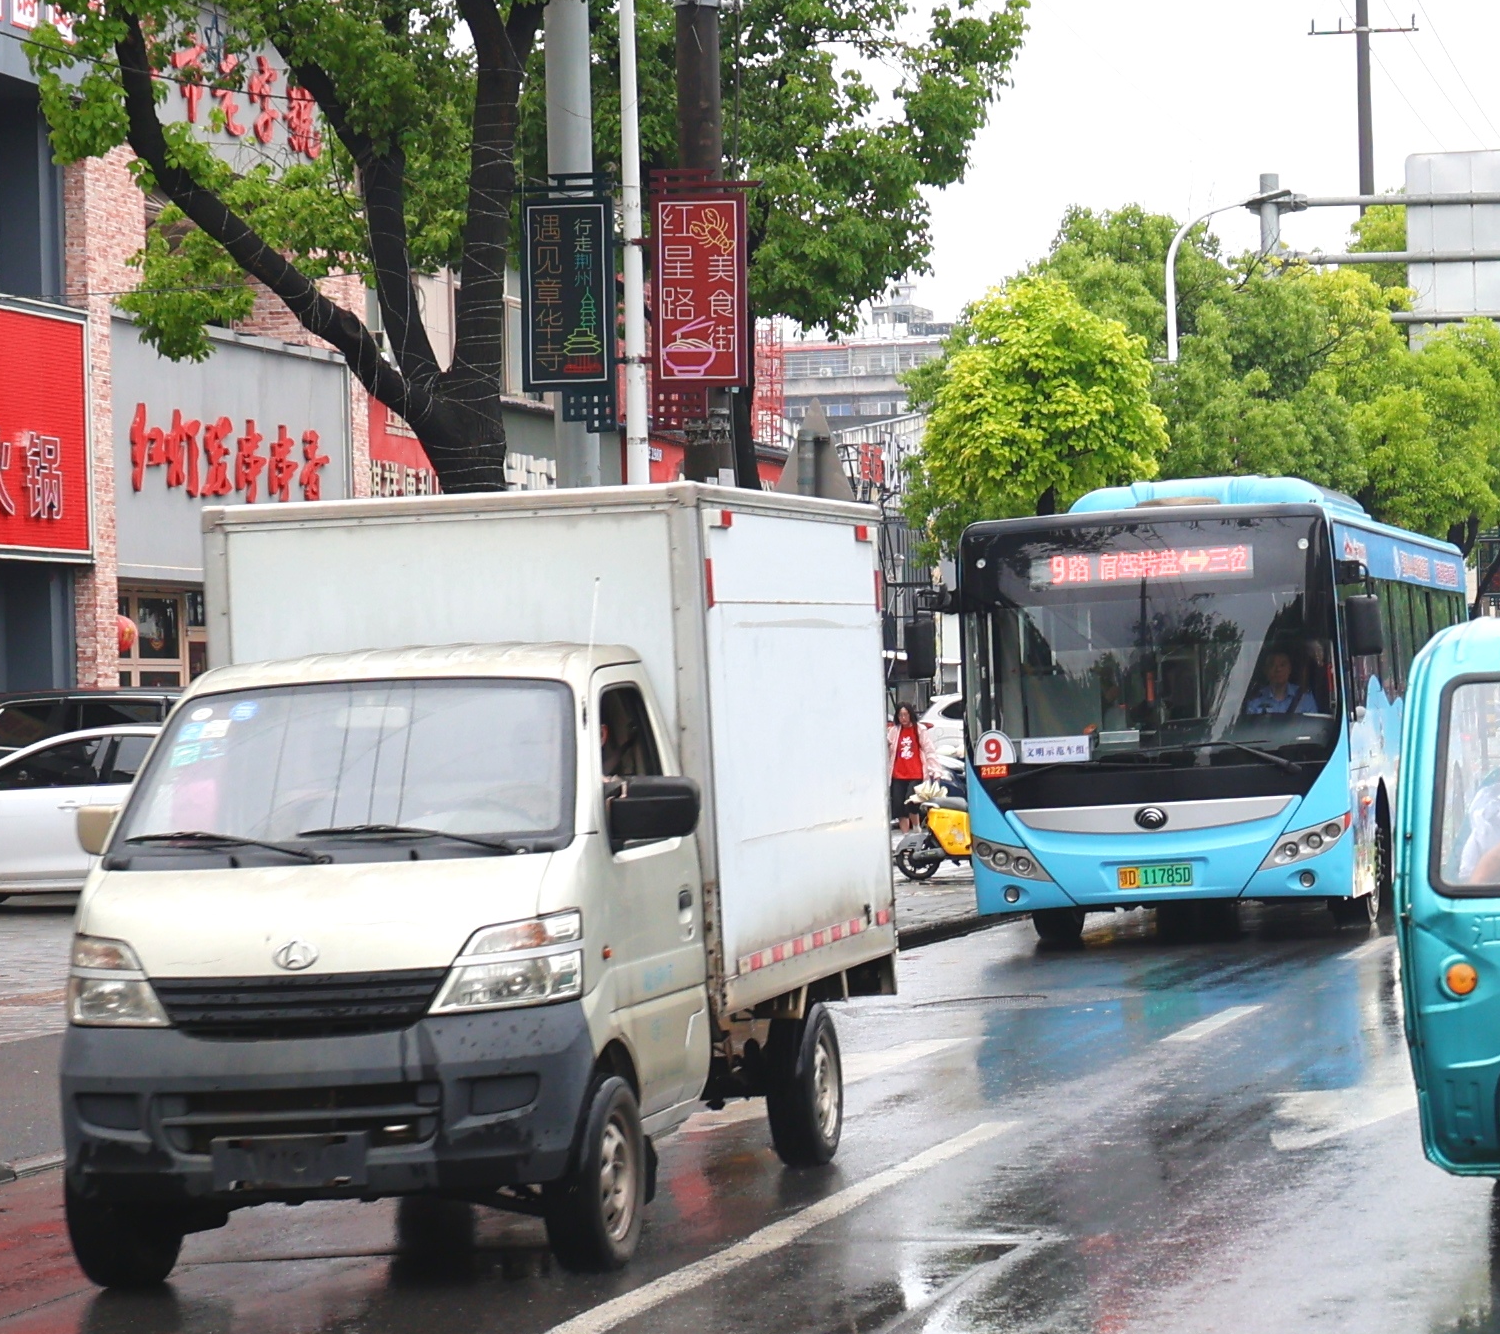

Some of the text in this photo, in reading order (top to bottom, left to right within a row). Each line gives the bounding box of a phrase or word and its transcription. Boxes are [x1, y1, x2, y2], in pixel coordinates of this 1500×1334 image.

[533, 213, 563, 372] 遇见章华寺
[573, 218, 593, 288] 行走荆州
[662, 204, 695, 321] 红星路
[706, 254, 736, 354] 美食街
[984, 738, 1002, 762] 9
